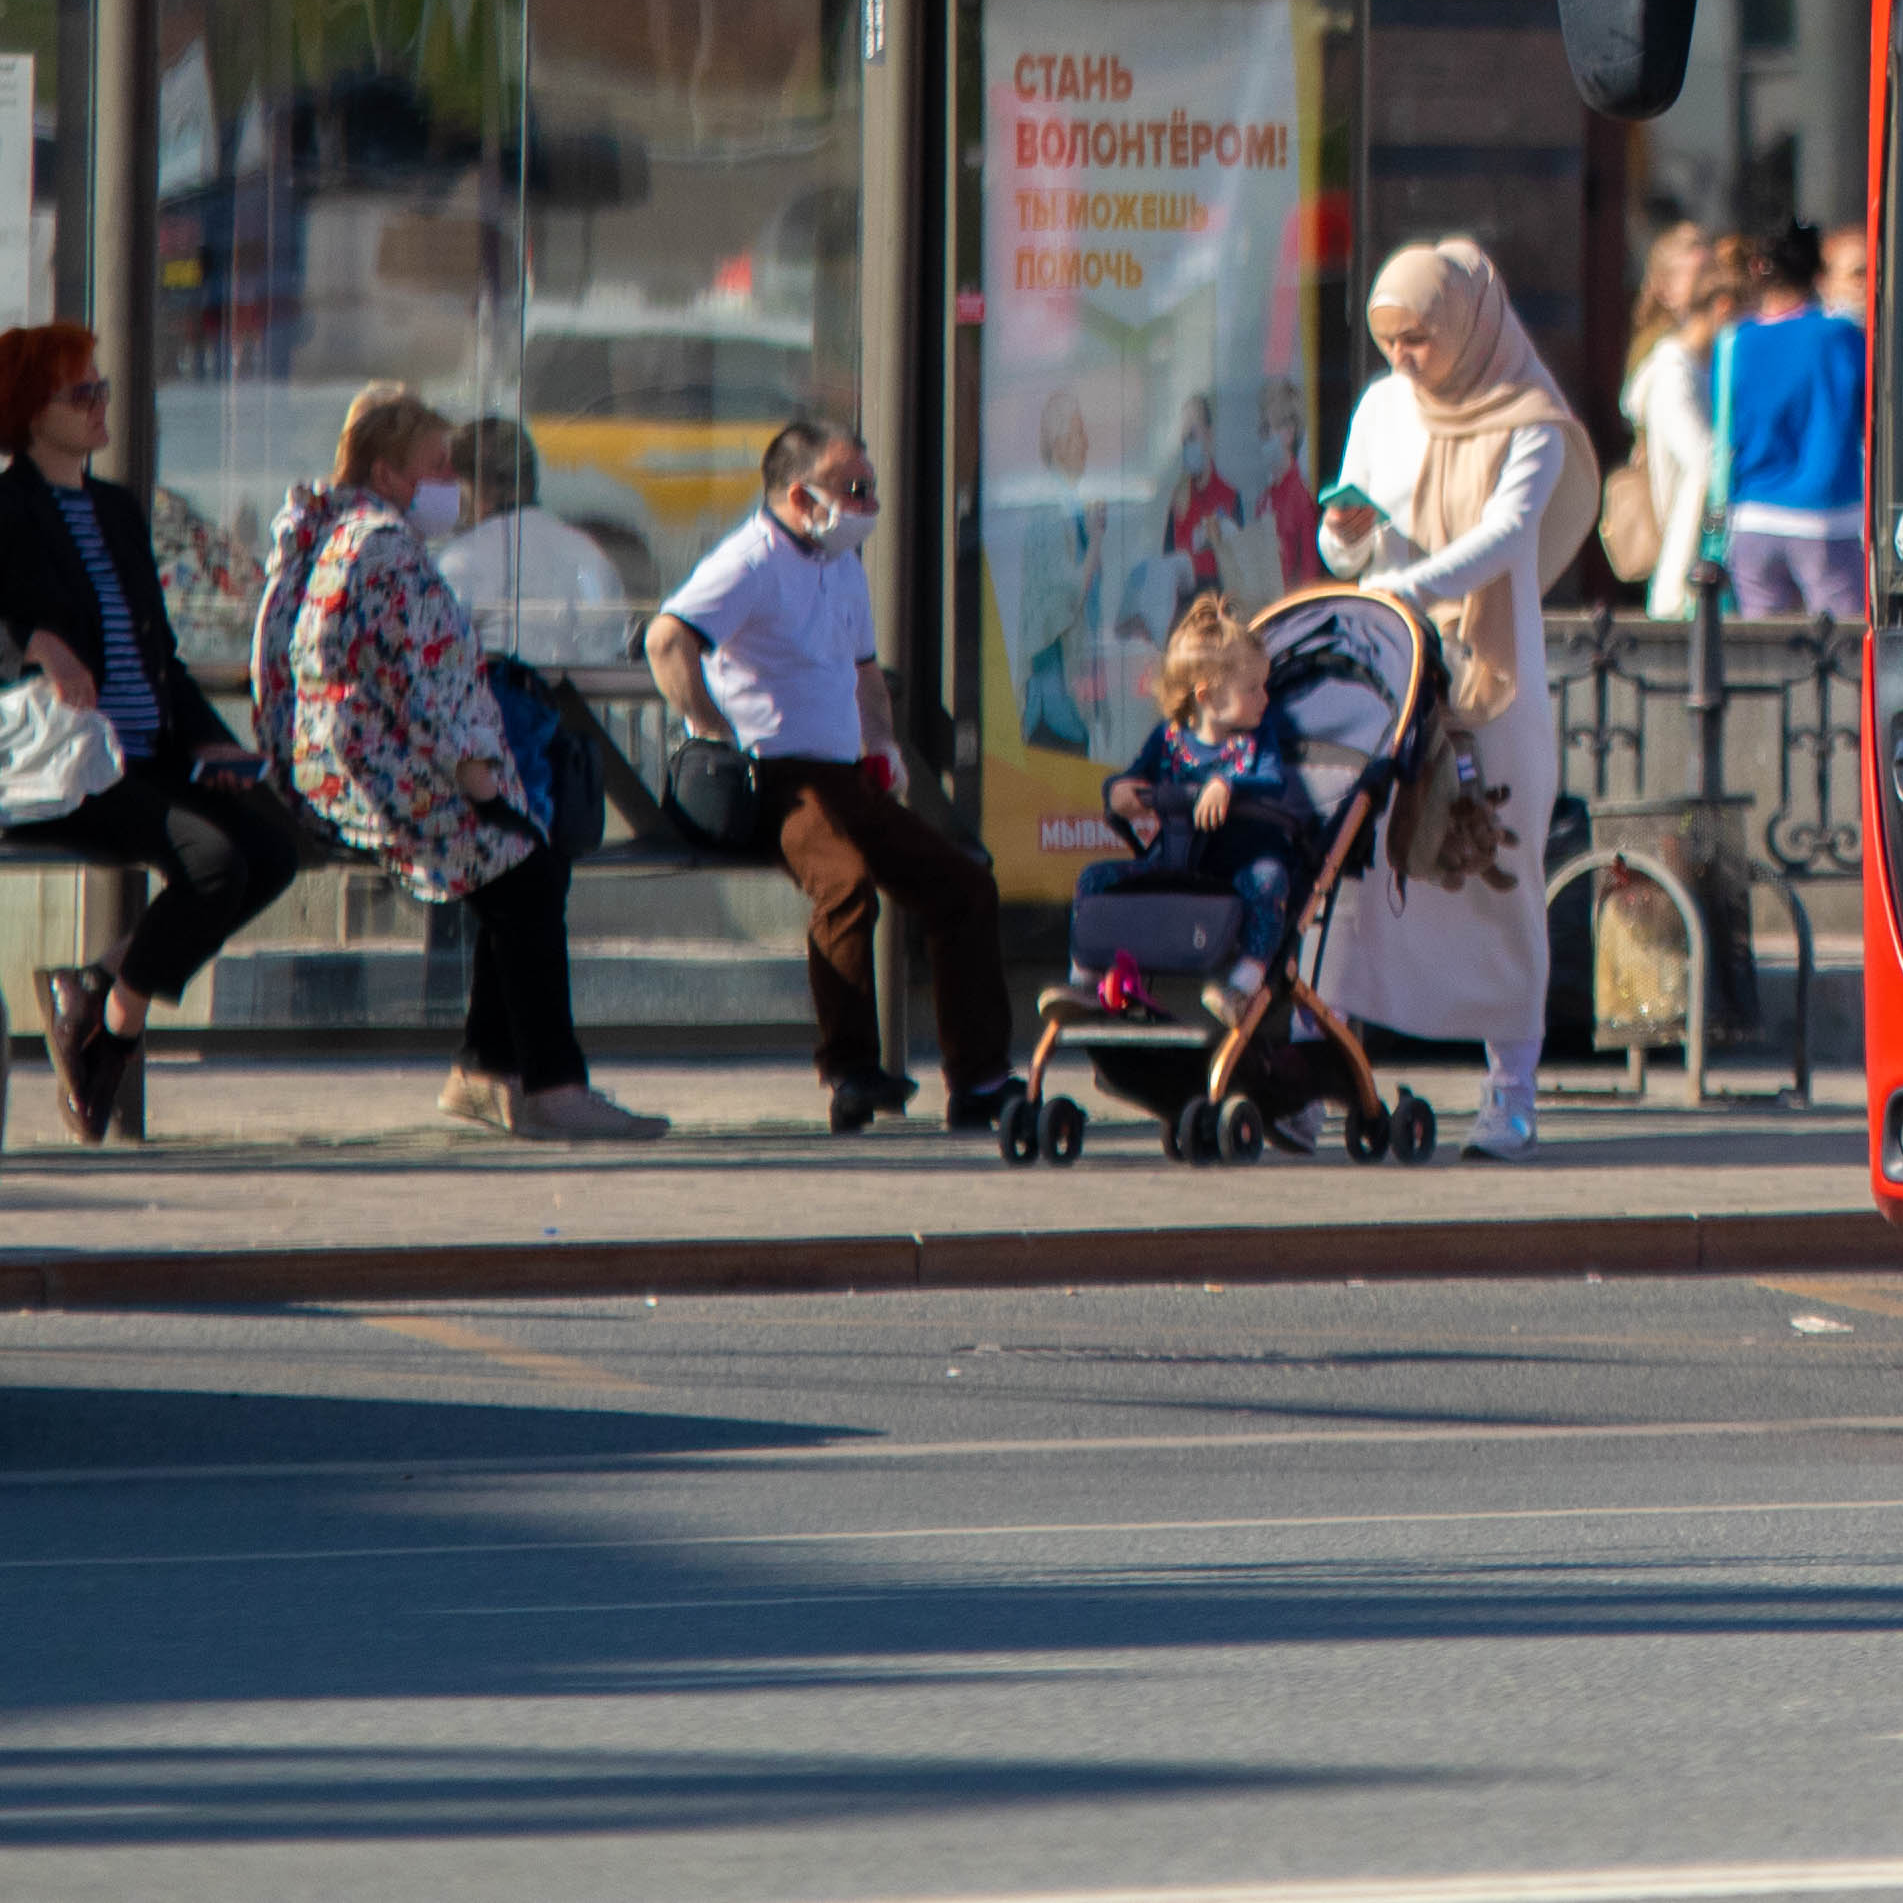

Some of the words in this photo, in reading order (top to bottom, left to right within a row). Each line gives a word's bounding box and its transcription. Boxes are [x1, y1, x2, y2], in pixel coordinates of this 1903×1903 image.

[1014, 53, 1134, 102] СТАНЬ
[1015, 108, 1288, 170] ВОЛОНТЁРОМ!
[1015, 188, 1057, 232] ТЫ
[1065, 189, 1209, 233] МОЖЕШЬ
[1015, 246, 1144, 291] ПОМОЧЬ
